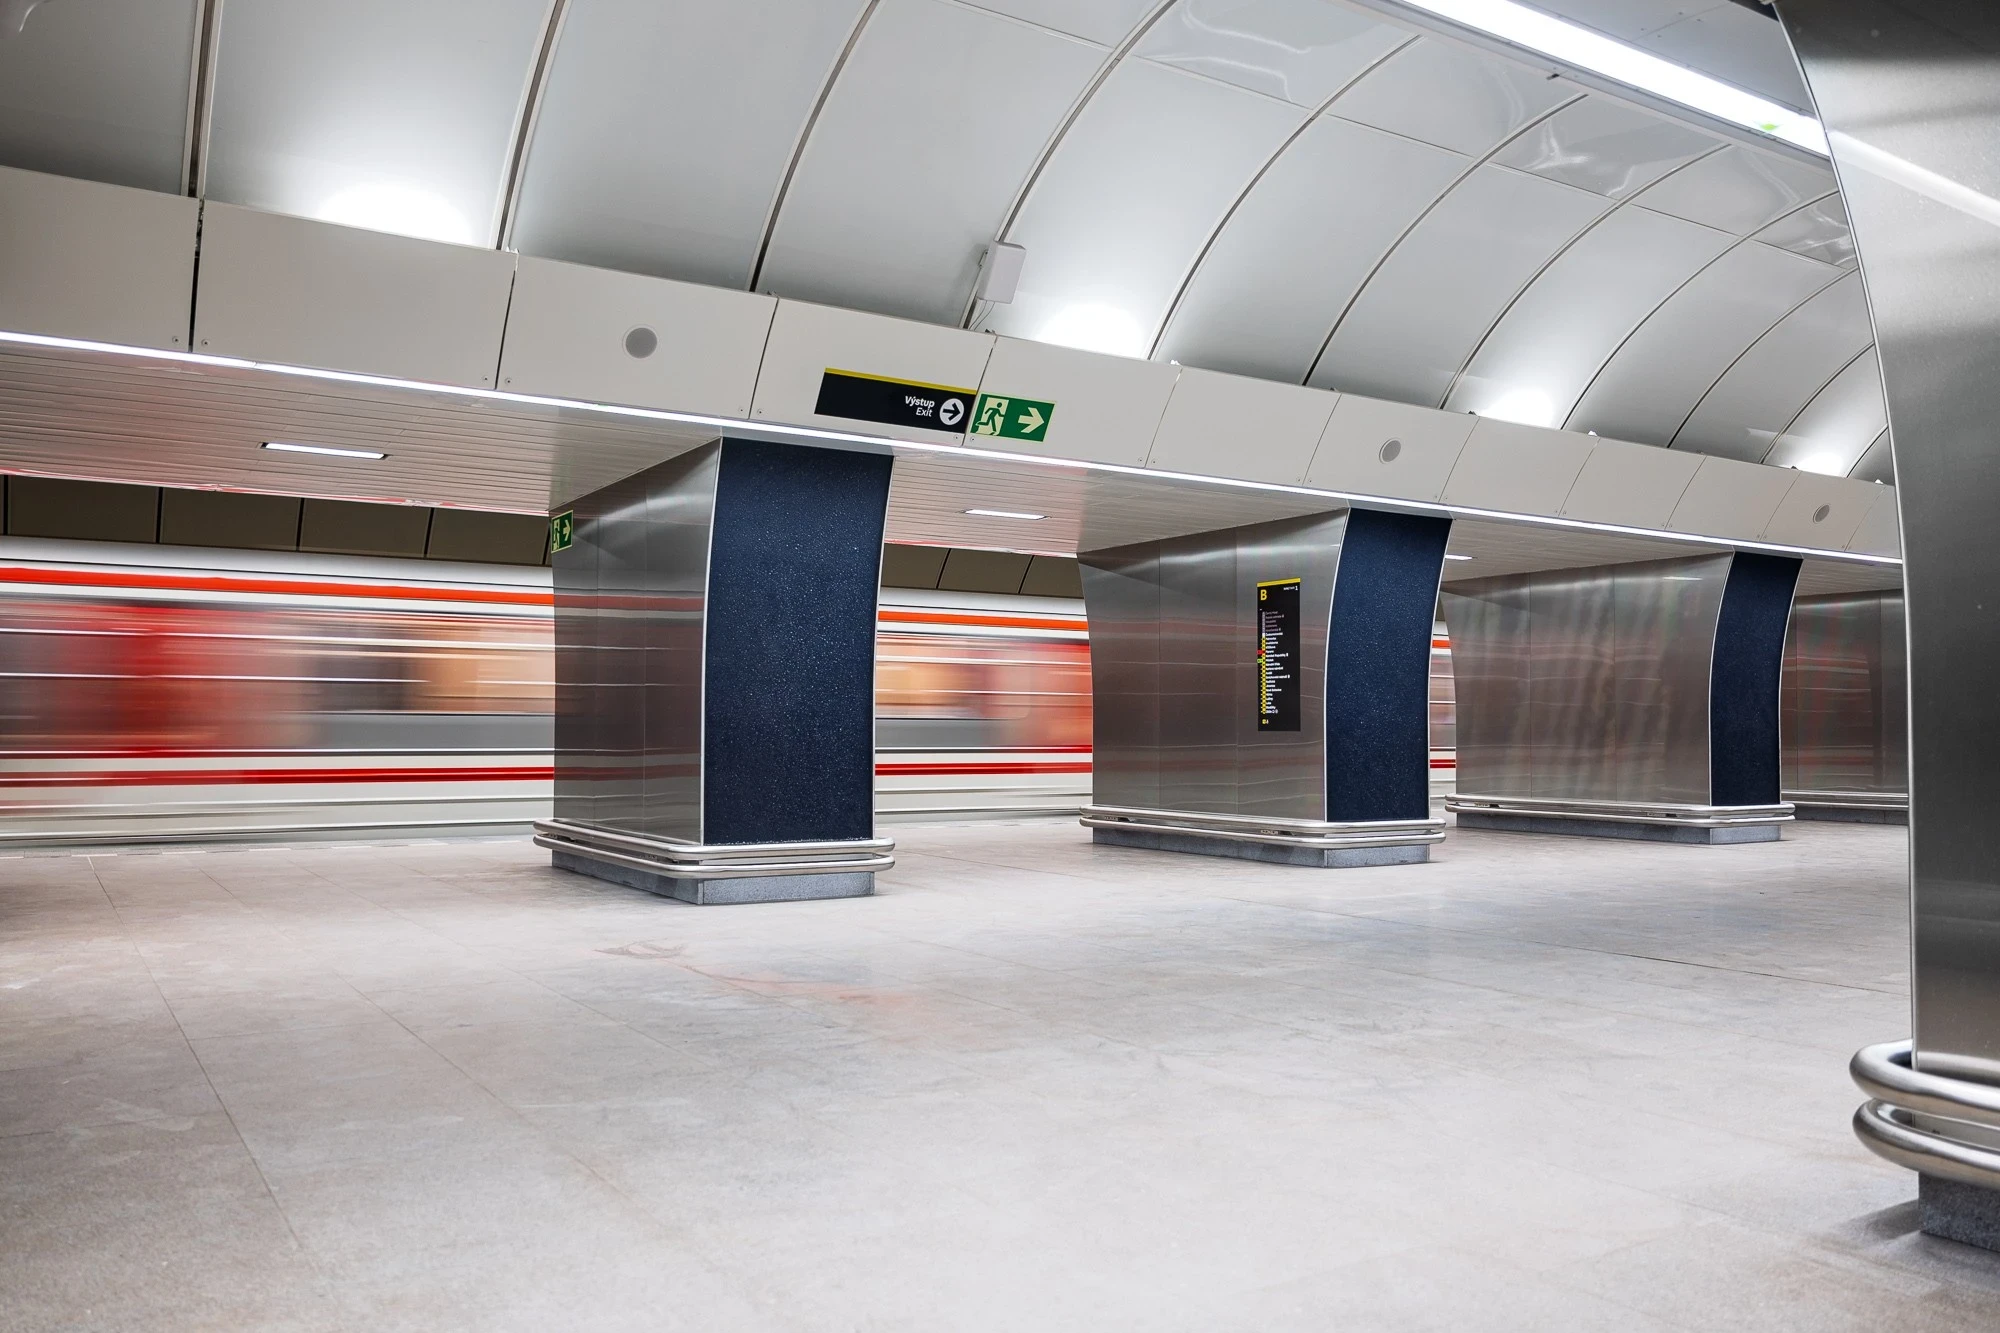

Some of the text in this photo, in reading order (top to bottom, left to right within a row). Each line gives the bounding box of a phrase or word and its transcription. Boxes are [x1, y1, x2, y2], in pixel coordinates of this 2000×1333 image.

[905, 395, 935, 408] Výstup
[916, 407, 933, 418] Exit
[1260, 589, 1267, 601] B
